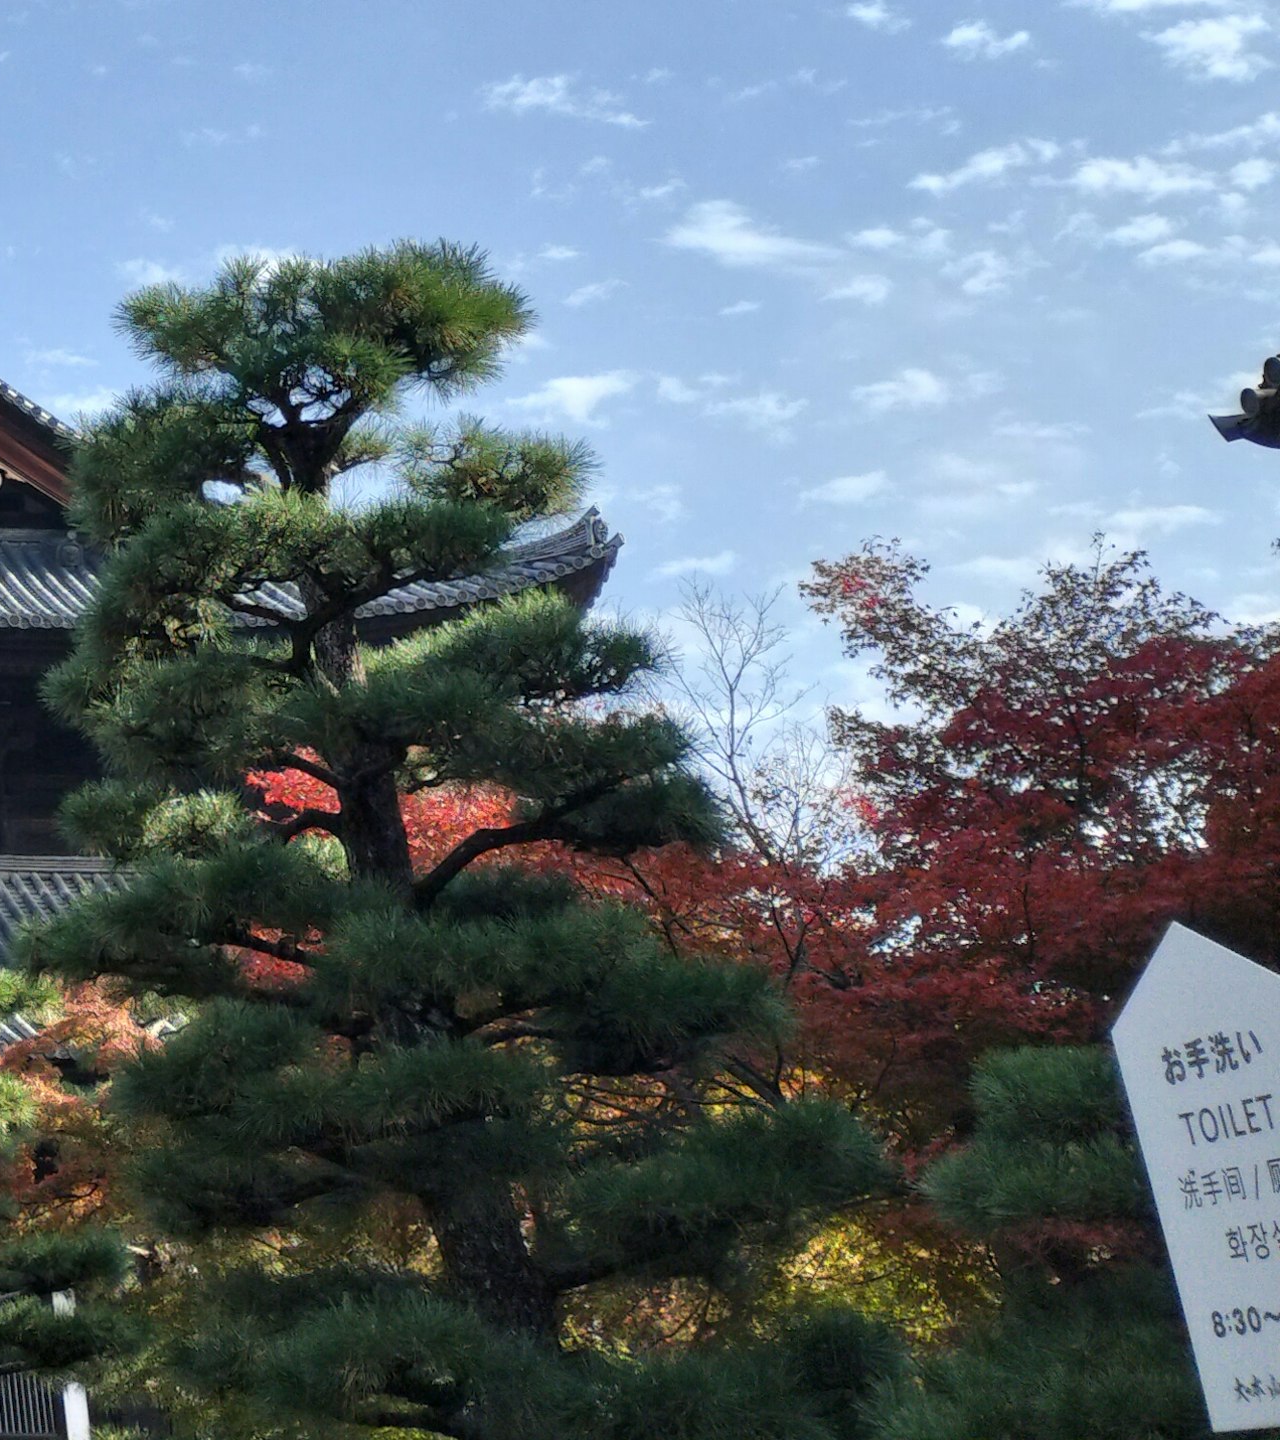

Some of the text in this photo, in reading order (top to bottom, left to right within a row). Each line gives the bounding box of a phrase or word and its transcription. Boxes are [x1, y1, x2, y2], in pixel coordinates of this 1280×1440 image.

[1161, 1030, 1263, 1085] お手洗い
[1178, 1094, 1274, 1146] TOILET
